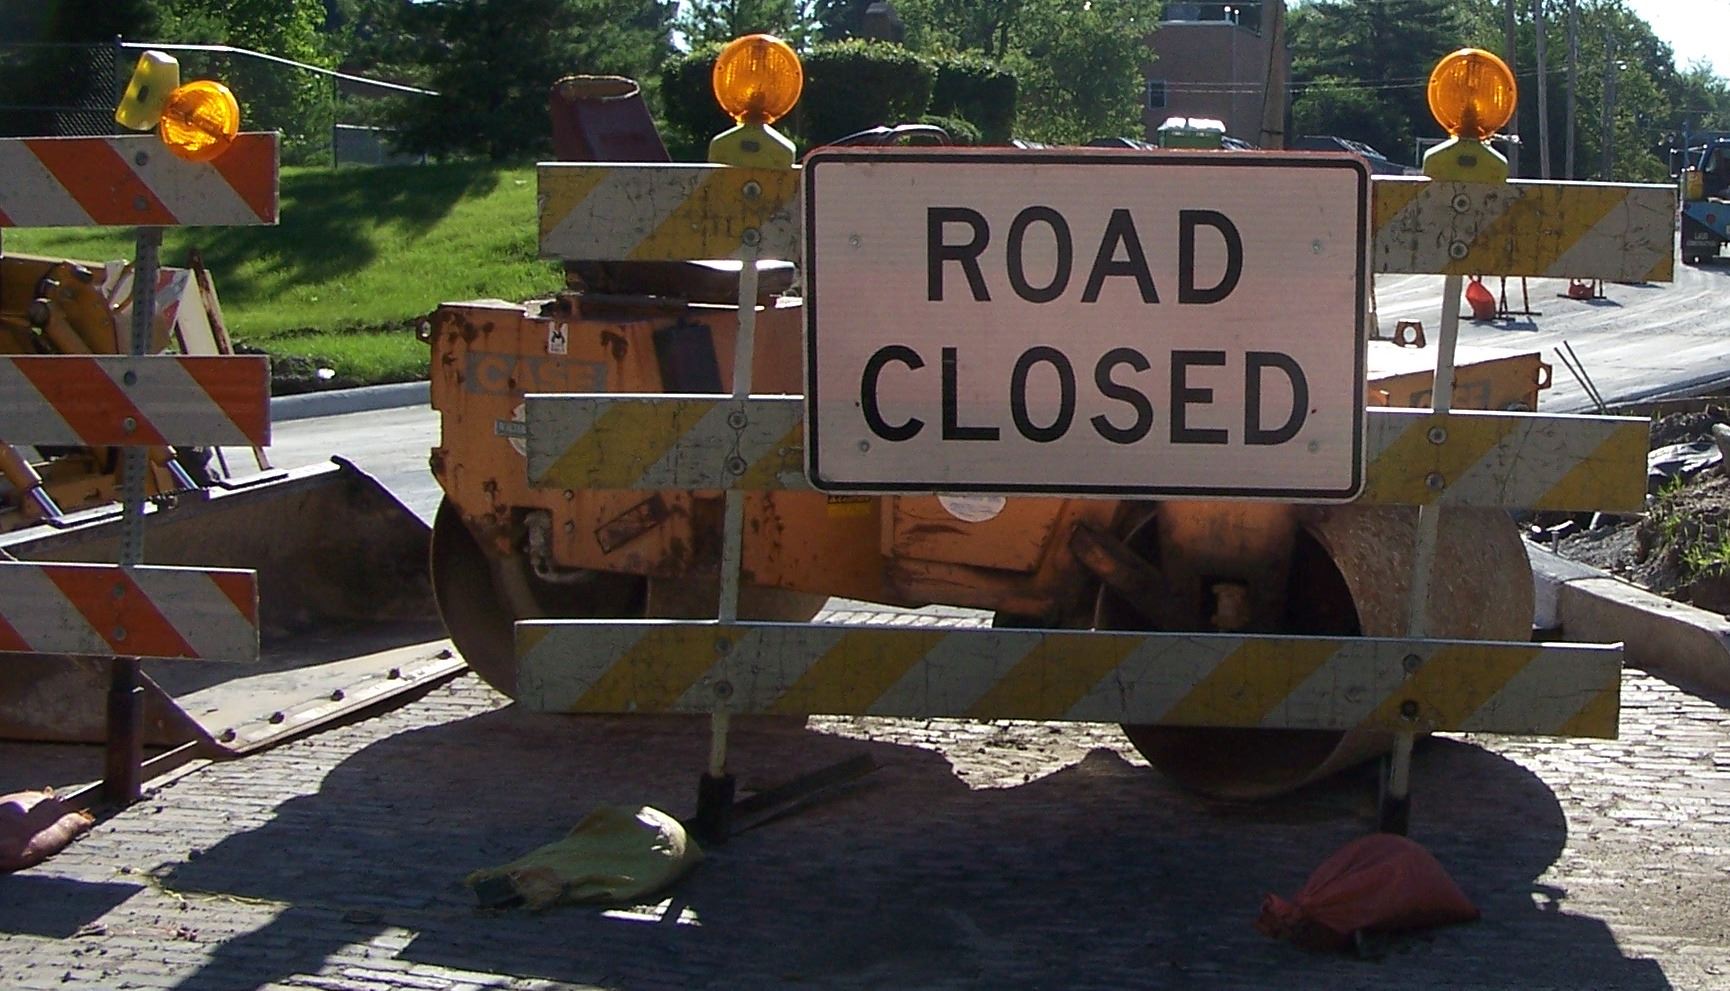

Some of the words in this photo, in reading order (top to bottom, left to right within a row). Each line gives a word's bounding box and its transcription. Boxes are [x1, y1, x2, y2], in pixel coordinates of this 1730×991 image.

[926, 205, 1244, 305] ROAD
[475, 354, 599, 393] CASE
[859, 344, 1309, 446] CLOSED
